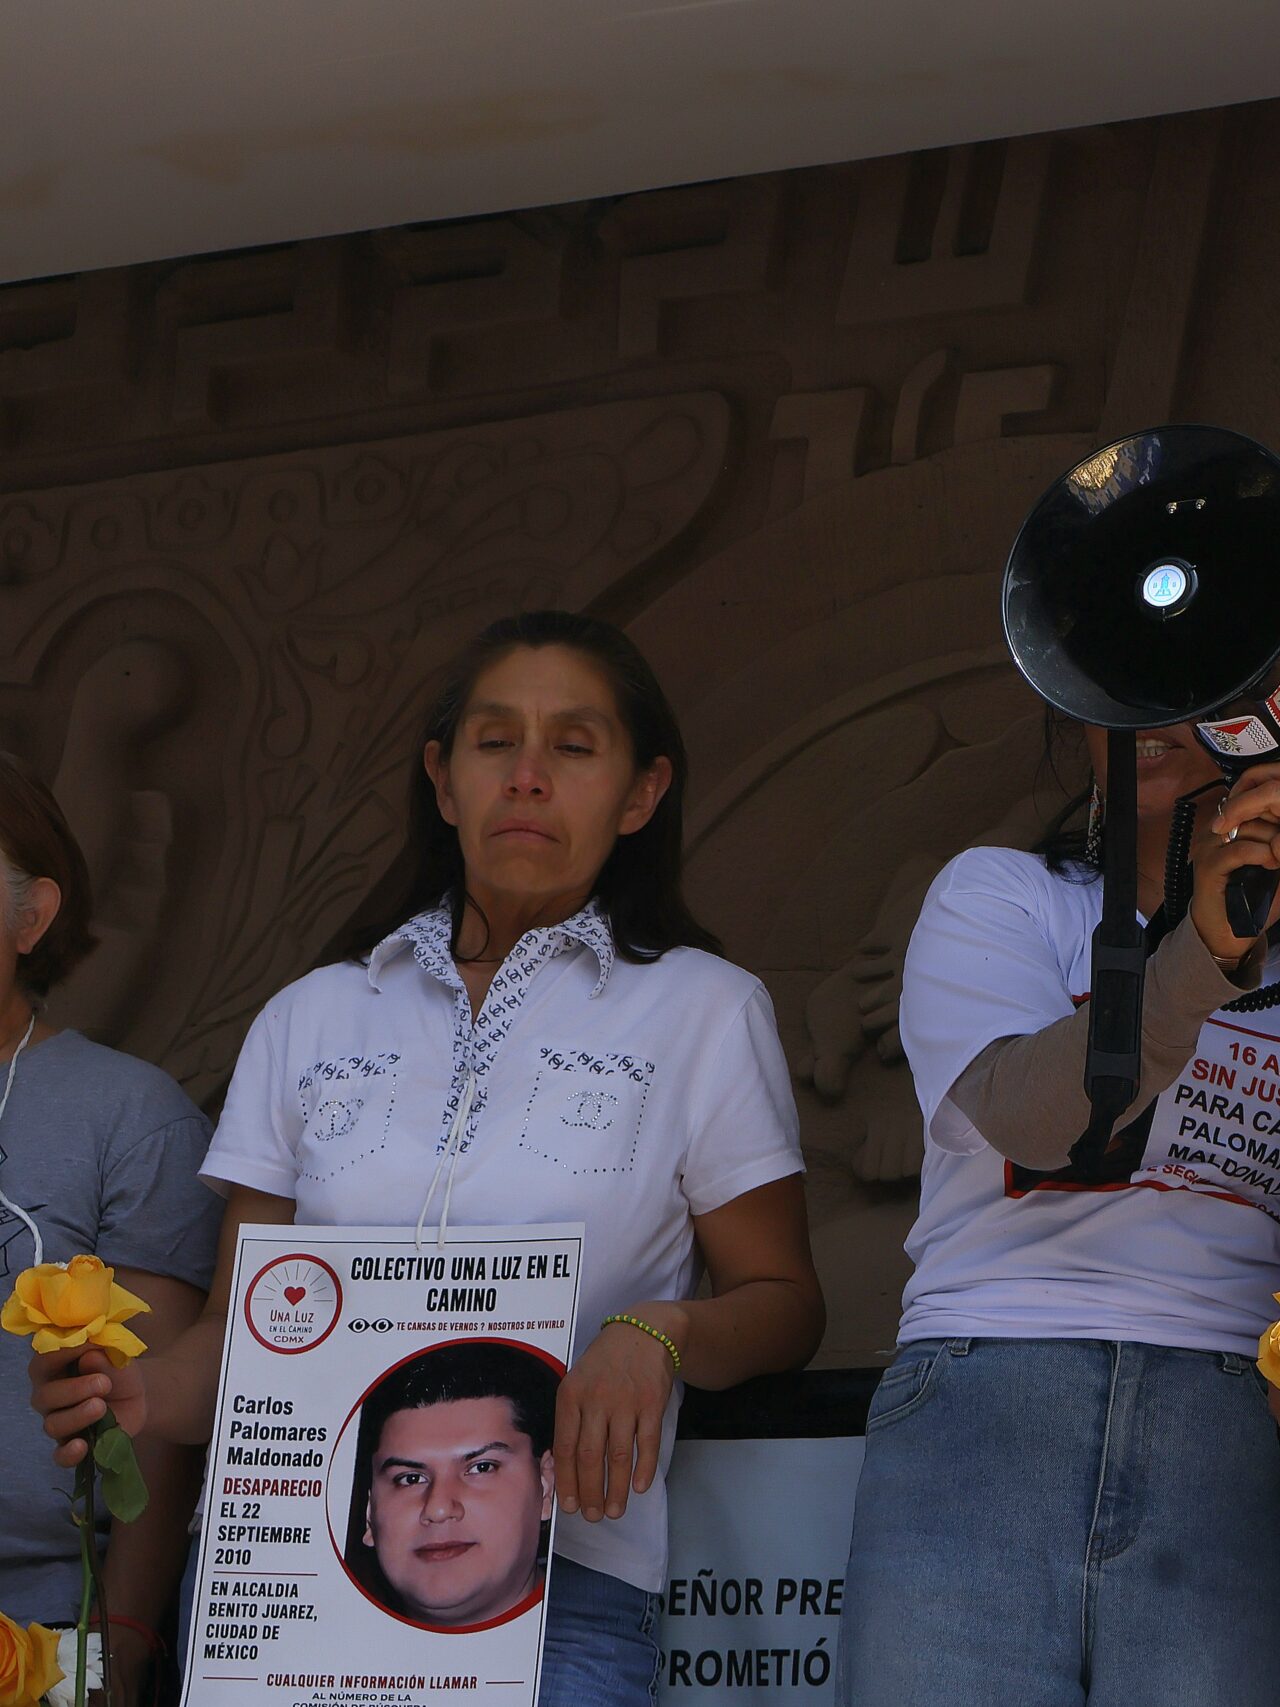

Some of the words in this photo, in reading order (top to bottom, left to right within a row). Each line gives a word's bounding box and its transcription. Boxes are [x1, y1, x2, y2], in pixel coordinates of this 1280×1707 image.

[1229, 1042, 1257, 1066] 16
[1192, 1058, 1237, 1090] SIN
[1174, 1084, 1244, 1125] PARA
[351, 1257, 445, 1281] COLECTIVO
[451, 1257, 486, 1281] UNA
[491, 1256, 522, 1280] LUZ
[526, 1255, 547, 1279] EN
[553, 1254, 570, 1278] EL
[426, 1288, 497, 1312] CAMINO
[397, 1322, 406, 1331] TE
[407, 1322, 436, 1331] CANSAS
[438, 1322, 448, 1331] DE
[450, 1322, 478, 1331] VERNOS
[488, 1322, 524, 1331] NOSOTROS
[526, 1321, 536, 1330] DE
[538, 1320, 565, 1329] VIVIRLO
[274, 1335, 304, 1343] CDMX
[233, 1395, 293, 1415] Carlos
[230, 1421, 327, 1442] Palomares
[226, 1446, 323, 1468] Maldonado
[223, 1477, 322, 1497] DESAPARECIO
[220, 1502, 237, 1518] EL
[241, 1502, 261, 1519] 22
[217, 1525, 311, 1544] SEPTIEMBRE
[214, 1548, 251, 1565] 2010
[211, 1581, 228, 1596] EN
[232, 1582, 298, 1598] ALCALDIA
[658, 1568, 764, 1616] EÑOR
[775, 1578, 845, 1616] PRE
[208, 1602, 258, 1618] BENITO
[262, 1604, 318, 1622] JUAREZ,
[206, 1623, 258, 1639] CIUDAD
[262, 1625, 280, 1640] DE
[203, 1642, 259, 1660] MÉXICO
[266, 1673, 335, 1688] CUALQUIER
[340, 1674, 425, 1689] INFORMACIÓN
[429, 1676, 478, 1689] LLAMAR
[312, 1692, 326, 1700] AL
[329, 1691, 378, 1701] NÚMERO
[380, 1693, 395, 1701] DE
[398, 1694, 412, 1702] LA
